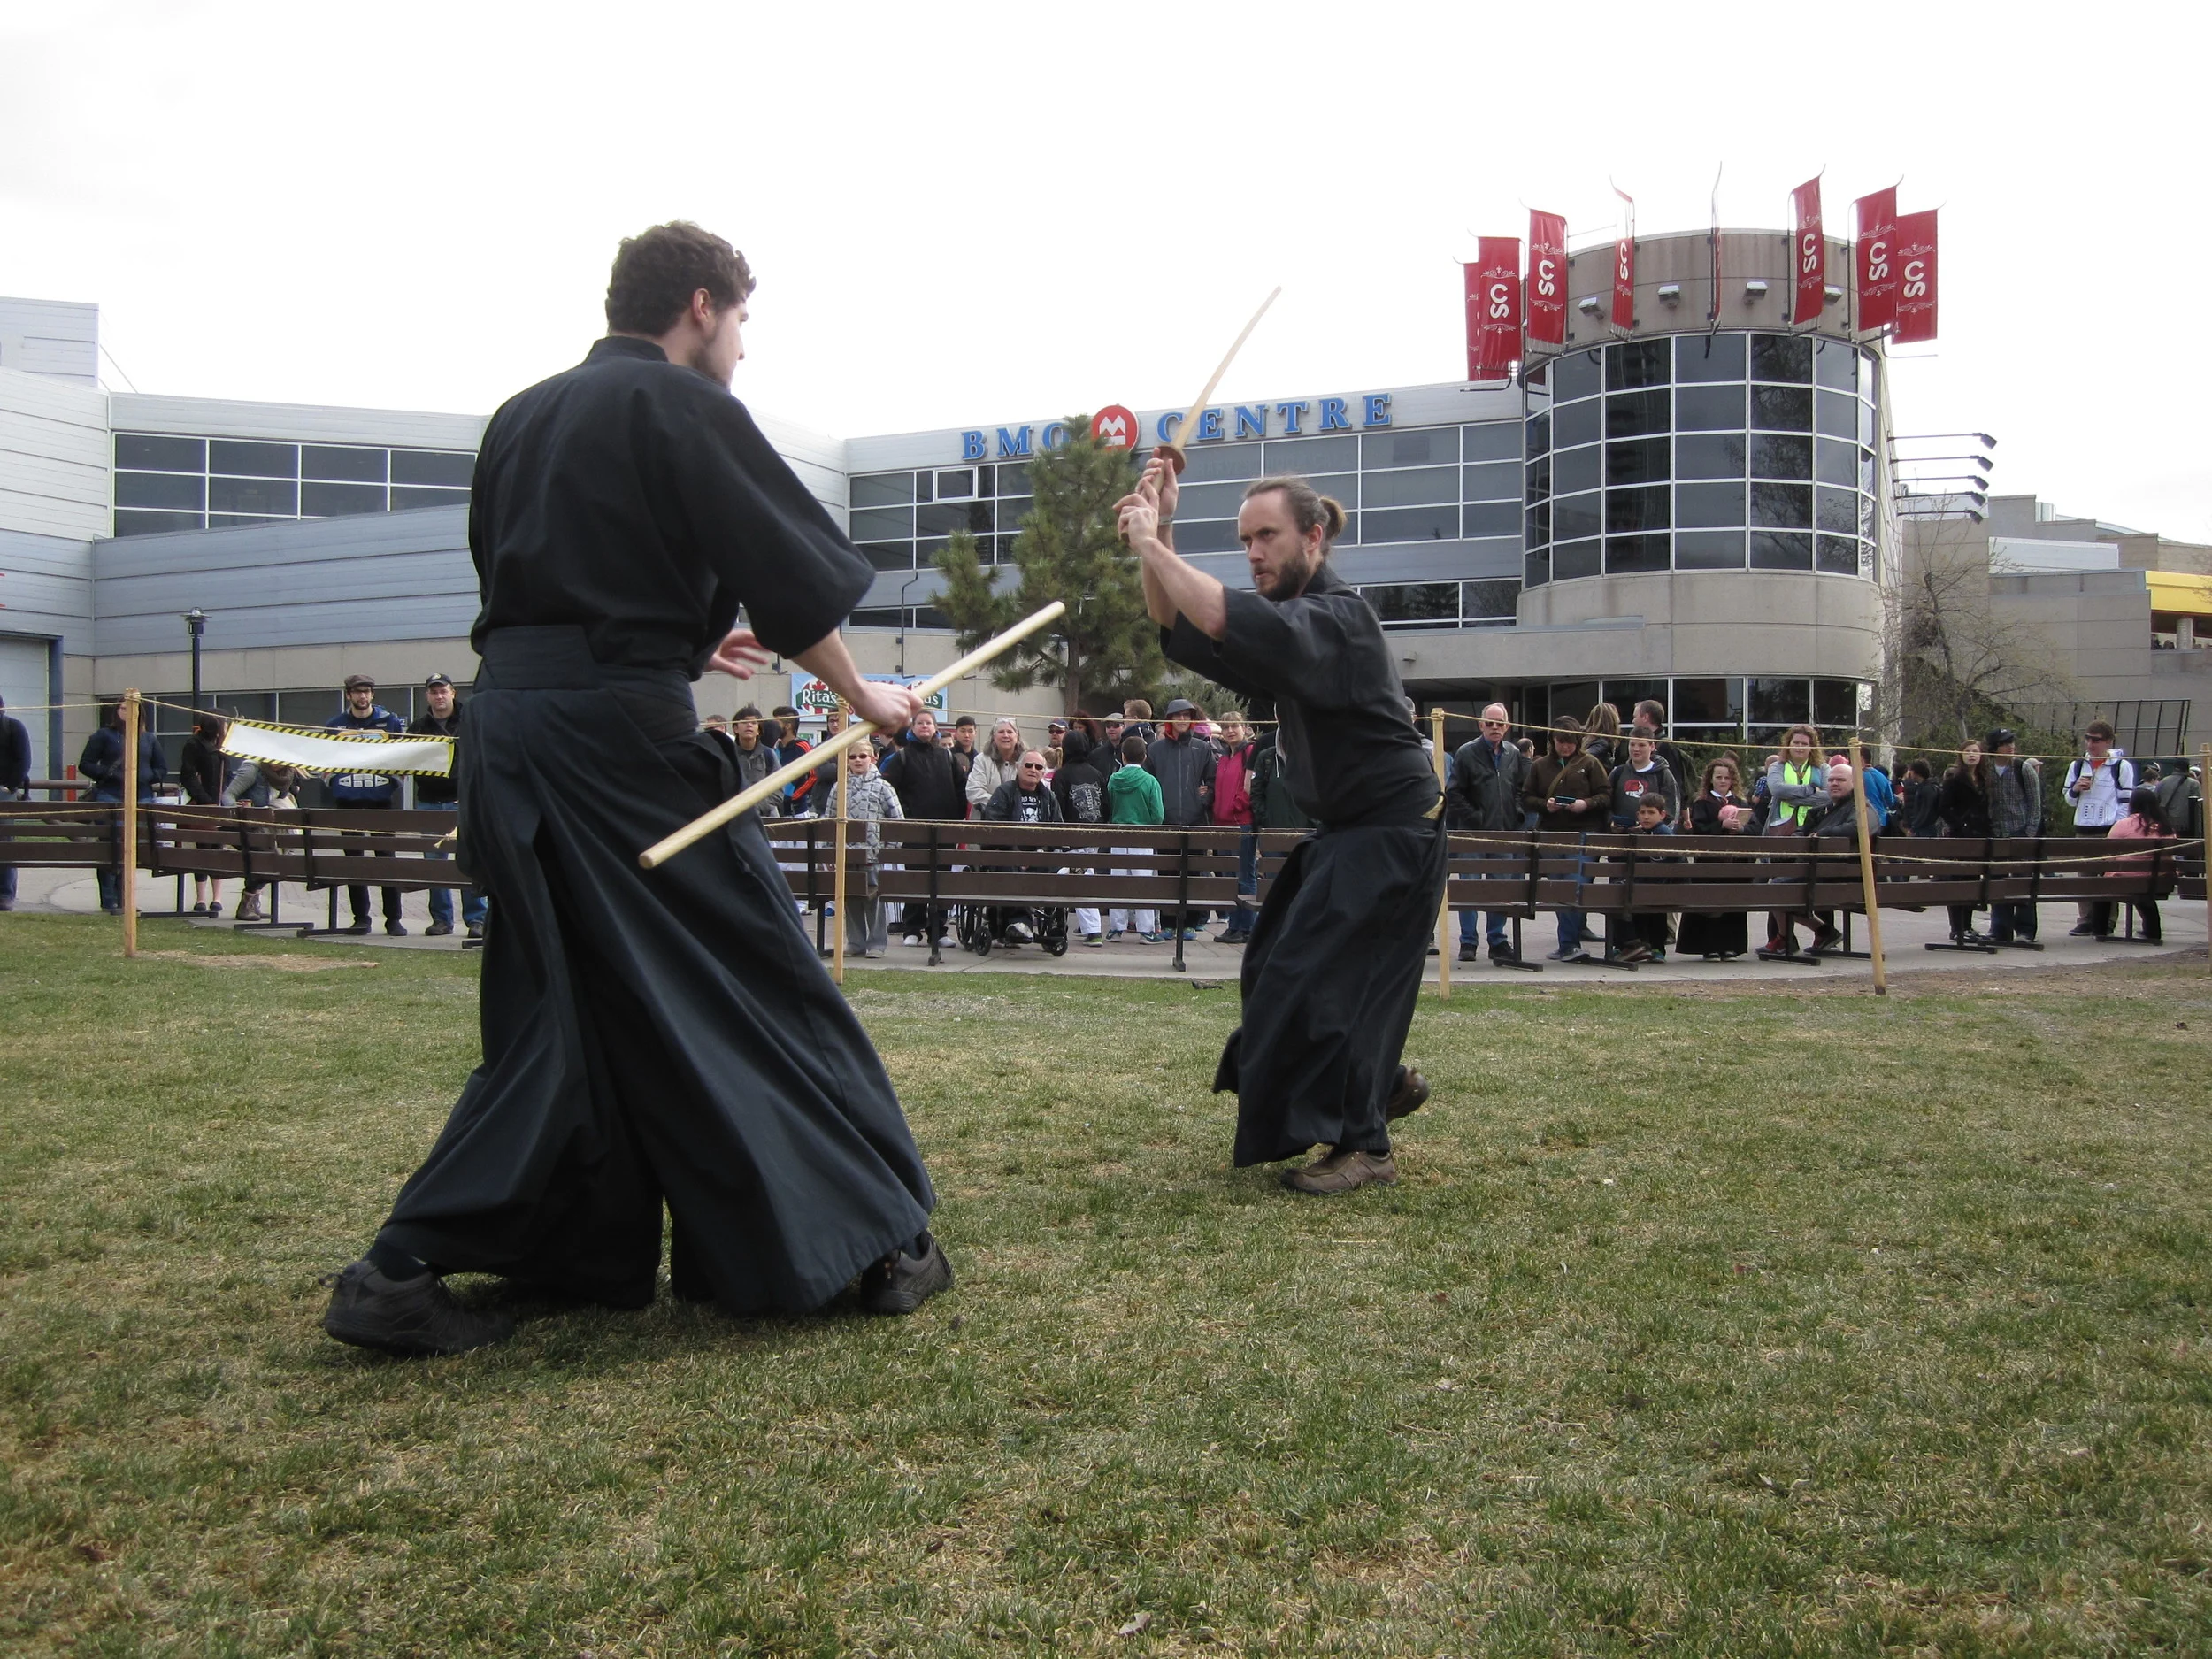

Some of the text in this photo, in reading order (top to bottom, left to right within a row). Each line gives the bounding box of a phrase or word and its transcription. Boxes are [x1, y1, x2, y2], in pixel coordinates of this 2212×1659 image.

[962, 421, 1070, 461] BMO
[1157, 393, 1393, 443] CENTRE
[802, 688, 837, 704] Rita's
